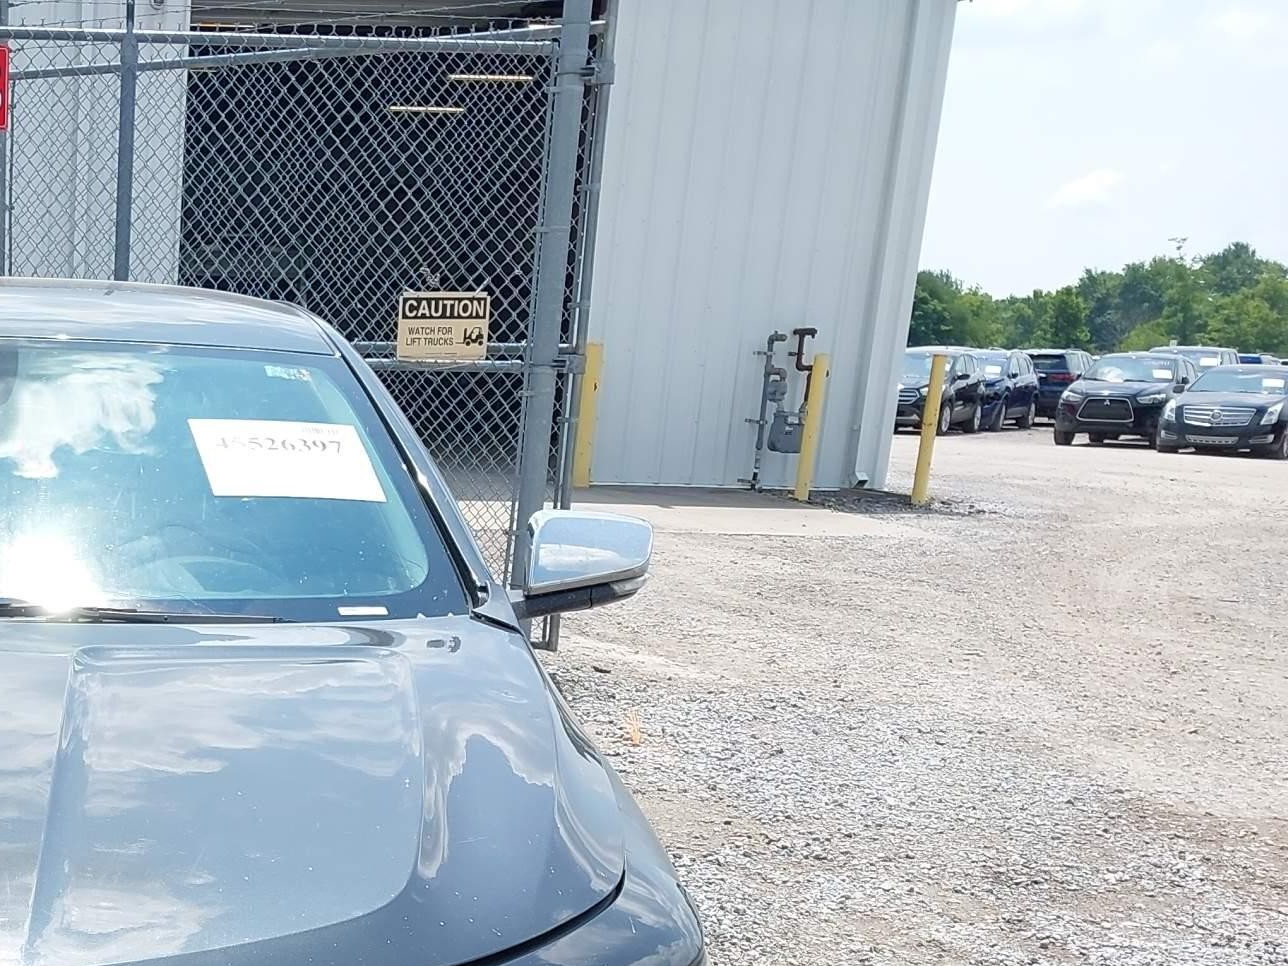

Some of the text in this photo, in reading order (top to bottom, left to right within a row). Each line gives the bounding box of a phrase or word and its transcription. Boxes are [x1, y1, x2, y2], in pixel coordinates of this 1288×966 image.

[404, 299, 485, 317] CAUTION
[408, 326, 453, 336] WATCH FOR
[405, 337, 454, 346] LIFT TRUCKS
